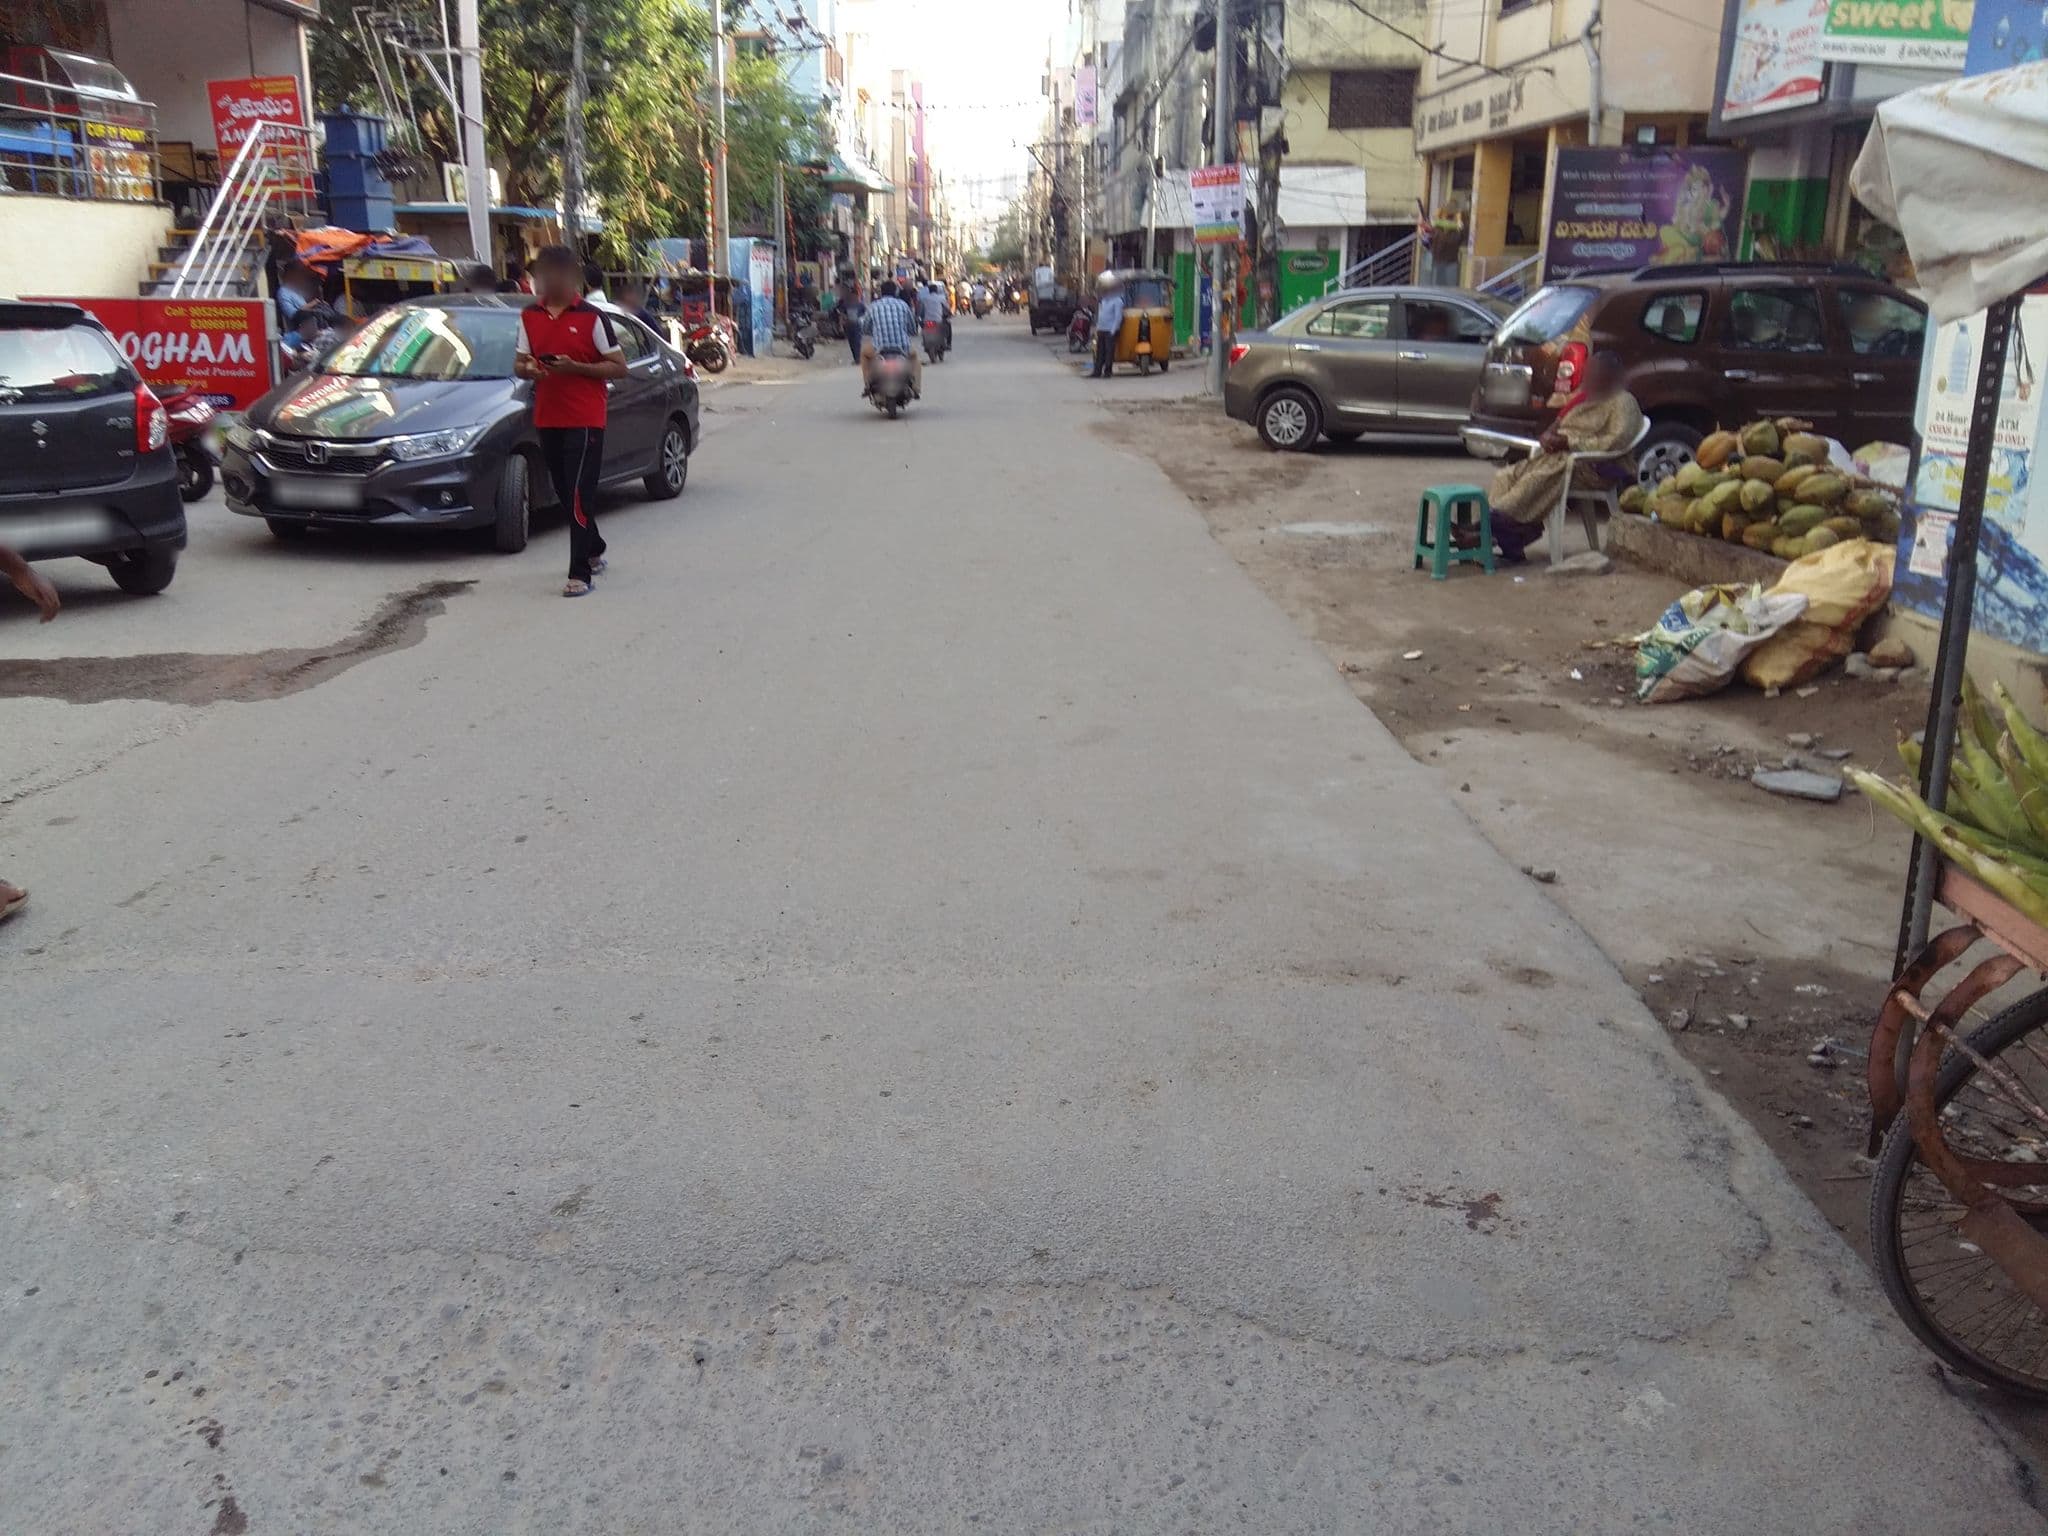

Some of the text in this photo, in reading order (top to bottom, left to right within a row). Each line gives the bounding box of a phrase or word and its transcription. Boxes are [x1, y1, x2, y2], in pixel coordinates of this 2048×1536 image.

[221, 126, 304, 144] AMGHAM
[118, 331, 256, 370] OGHAM
[185, 367, 257, 379] Food Paradise
[2004, 434, 2028, 446] ONLY
